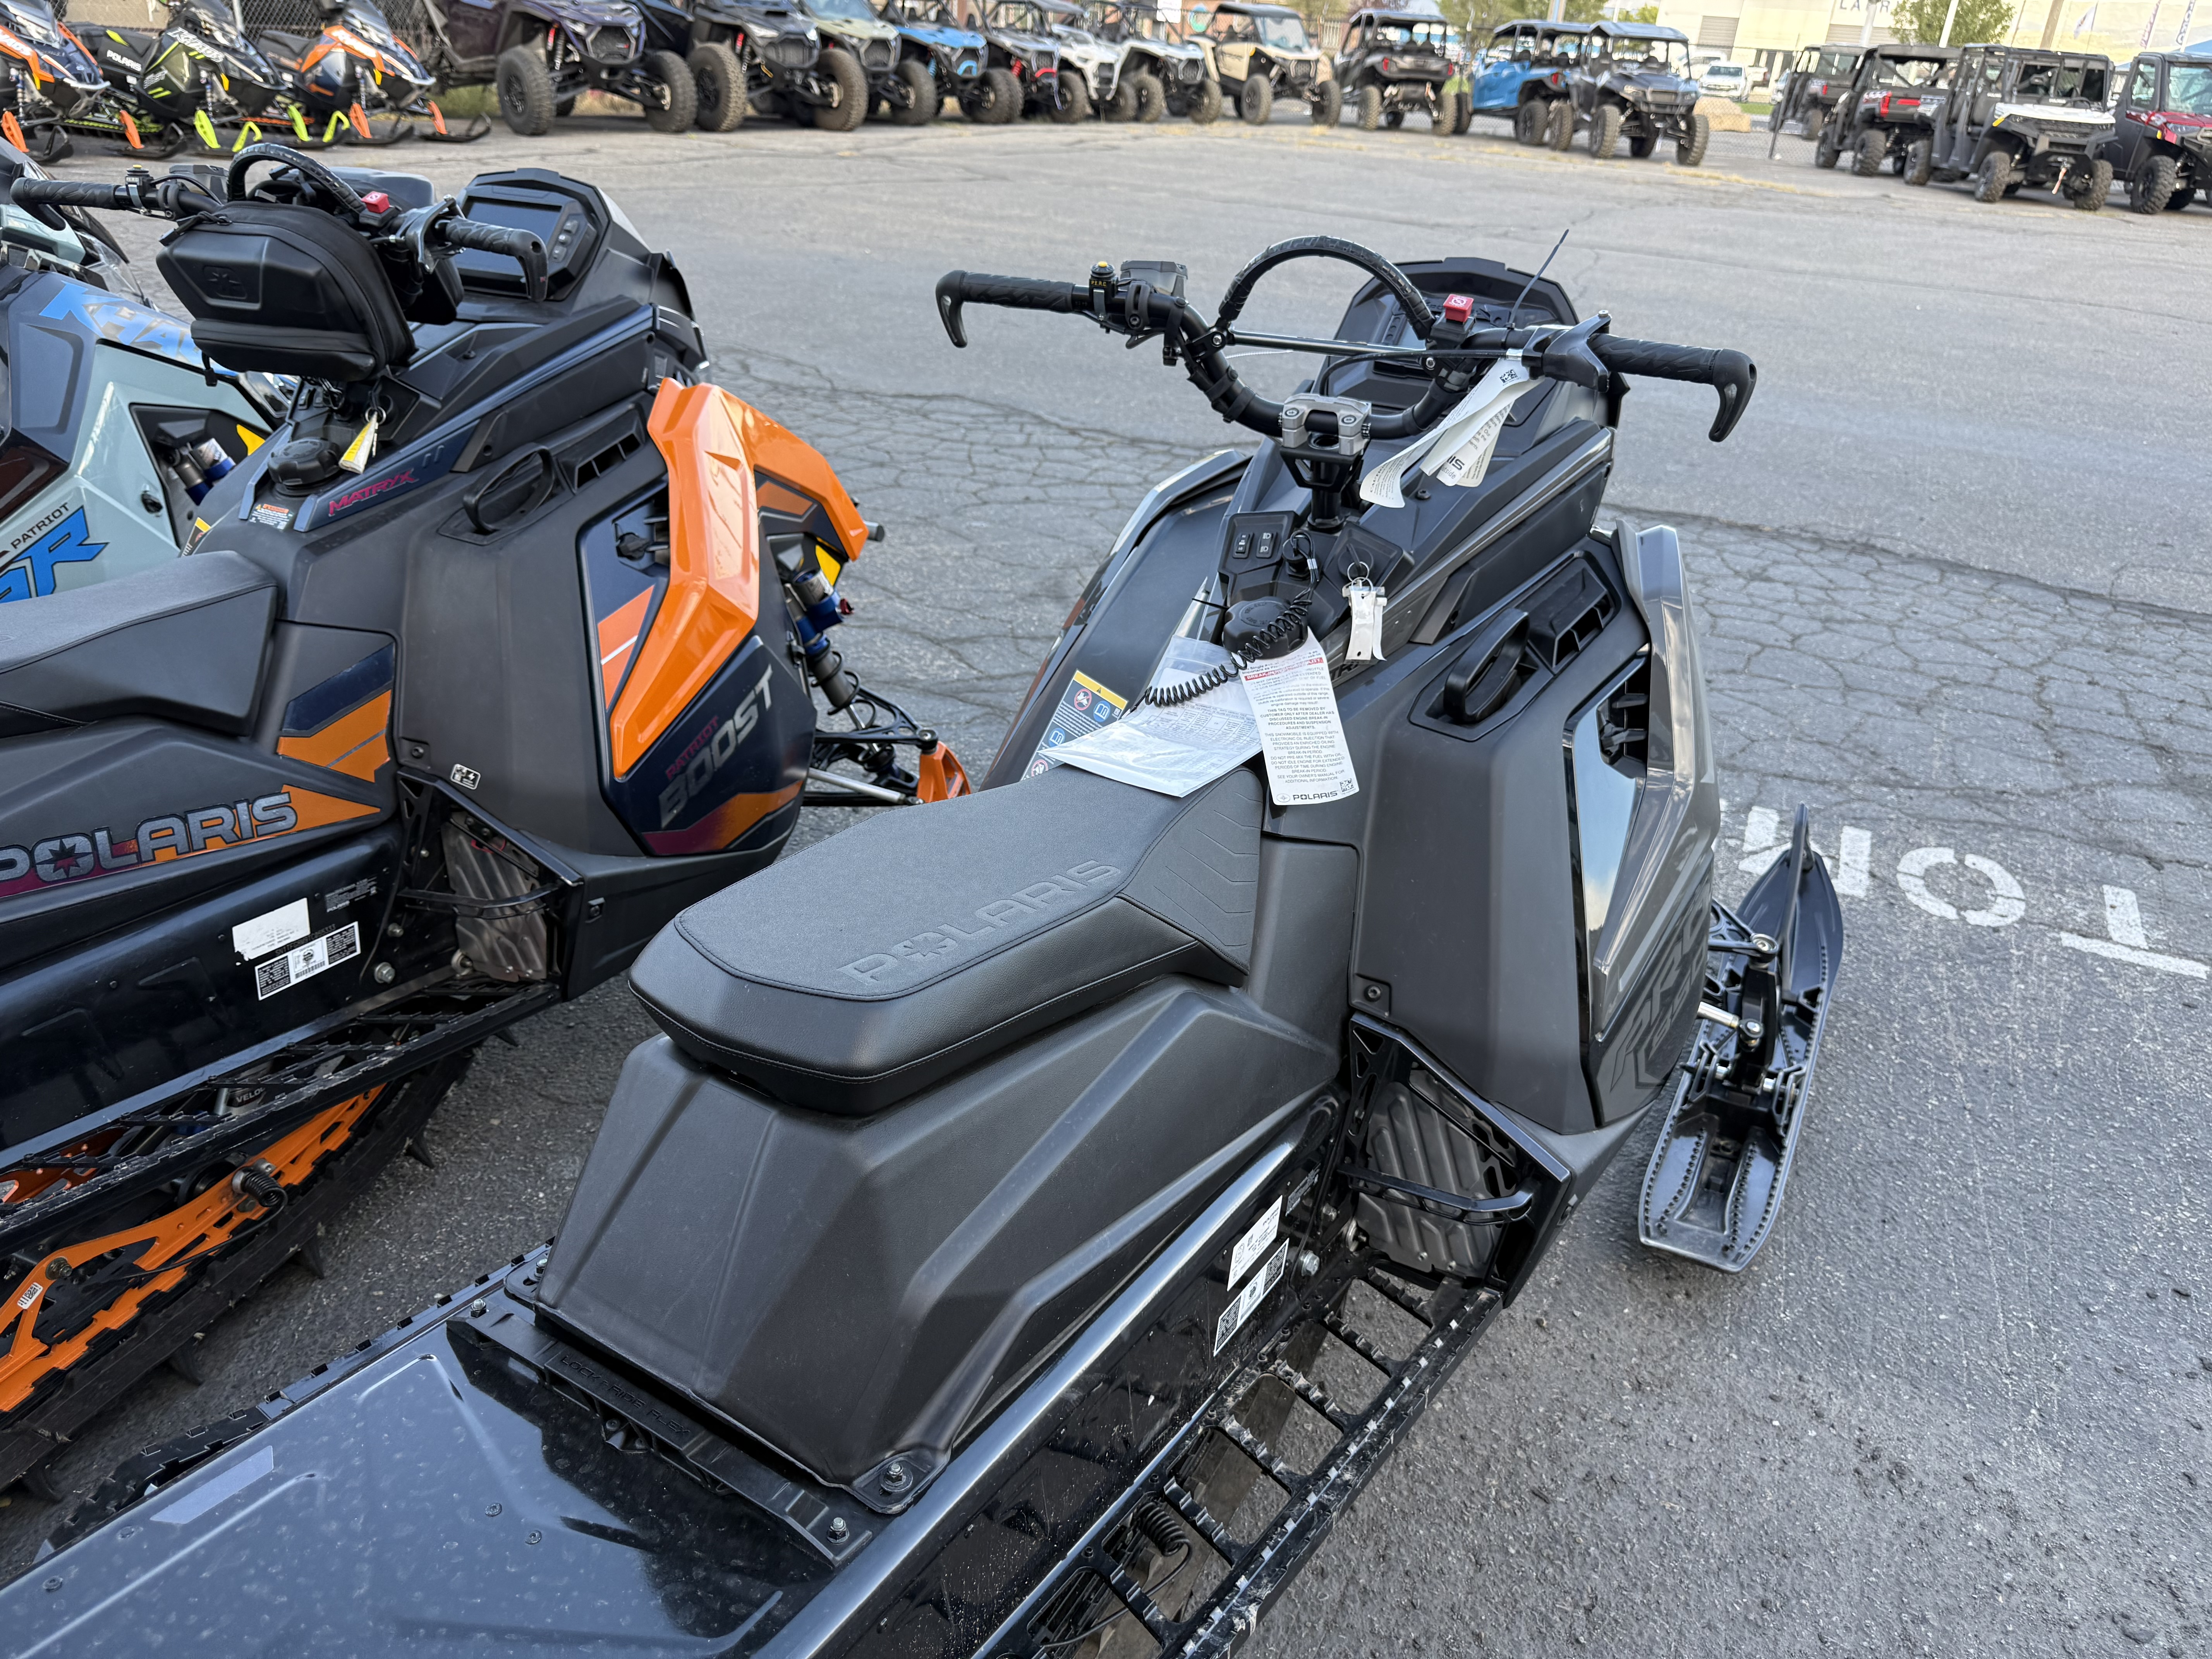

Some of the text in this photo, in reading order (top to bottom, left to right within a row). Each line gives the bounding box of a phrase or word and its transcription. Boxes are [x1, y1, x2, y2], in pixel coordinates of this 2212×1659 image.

[0, 29, 32, 56] AOS
[107, 50, 142, 72] POLARIS
[40, 280, 202, 366] KHA
[329, 468, 419, 517] MATRYX
[1370, 464, 1386, 493] CAUTIO
[10, 502, 70, 549] PATRIOT
[659, 664, 773, 828] BOOST
[666, 716, 720, 780] PATRIOT
[1293, 790, 1338, 801] POLARIS
[836, 859, 1121, 986] POLARIS
[561, 1355, 602, 1379] LOCK
[607, 1384, 646, 1409] RIDE
[646, 1408, 687, 1432] FLEX
